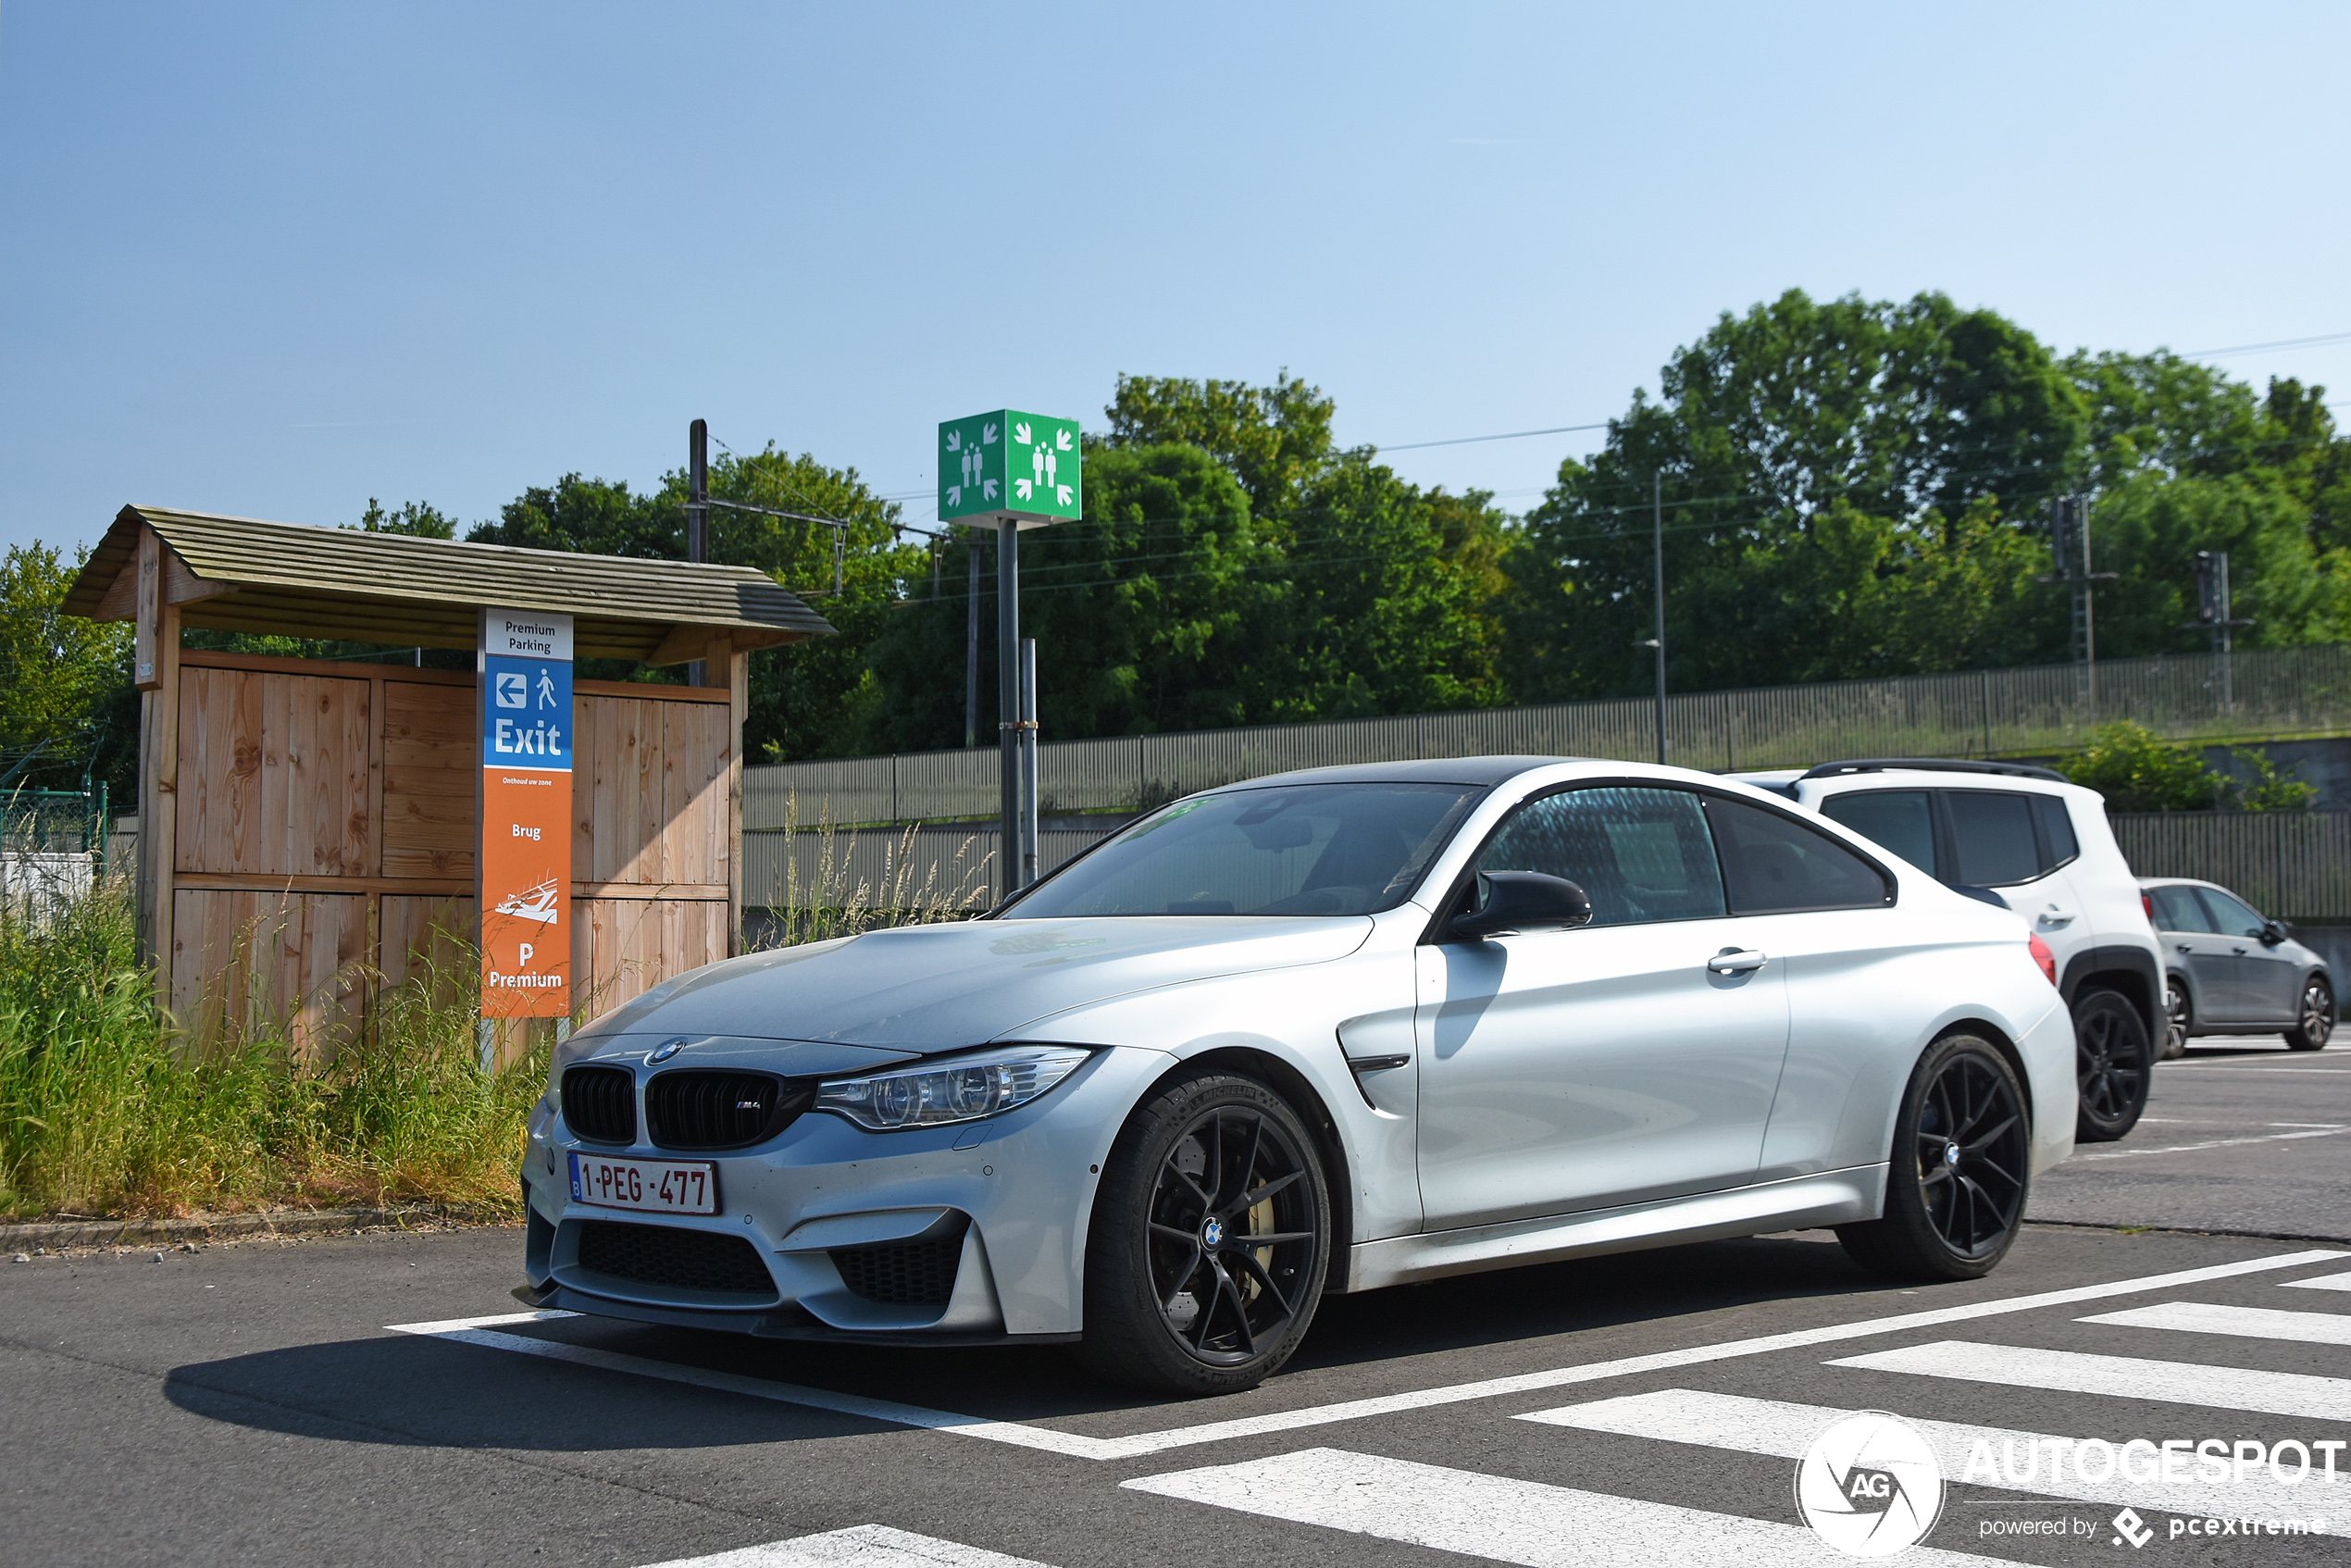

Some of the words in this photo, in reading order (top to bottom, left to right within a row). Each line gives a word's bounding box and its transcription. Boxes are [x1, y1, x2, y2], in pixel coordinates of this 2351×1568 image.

[505, 621, 555, 636] Premium
[509, 638, 551, 654] Parking
[495, 718, 561, 755] Exit
[503, 777, 528, 785] Onthoud
[512, 824, 541, 840] Brug
[519, 943, 534, 966] P
[490, 971, 562, 988] Premium
[1202, 1084, 1256, 1102] MICHELIN
[573, 1181, 580, 1196] B
